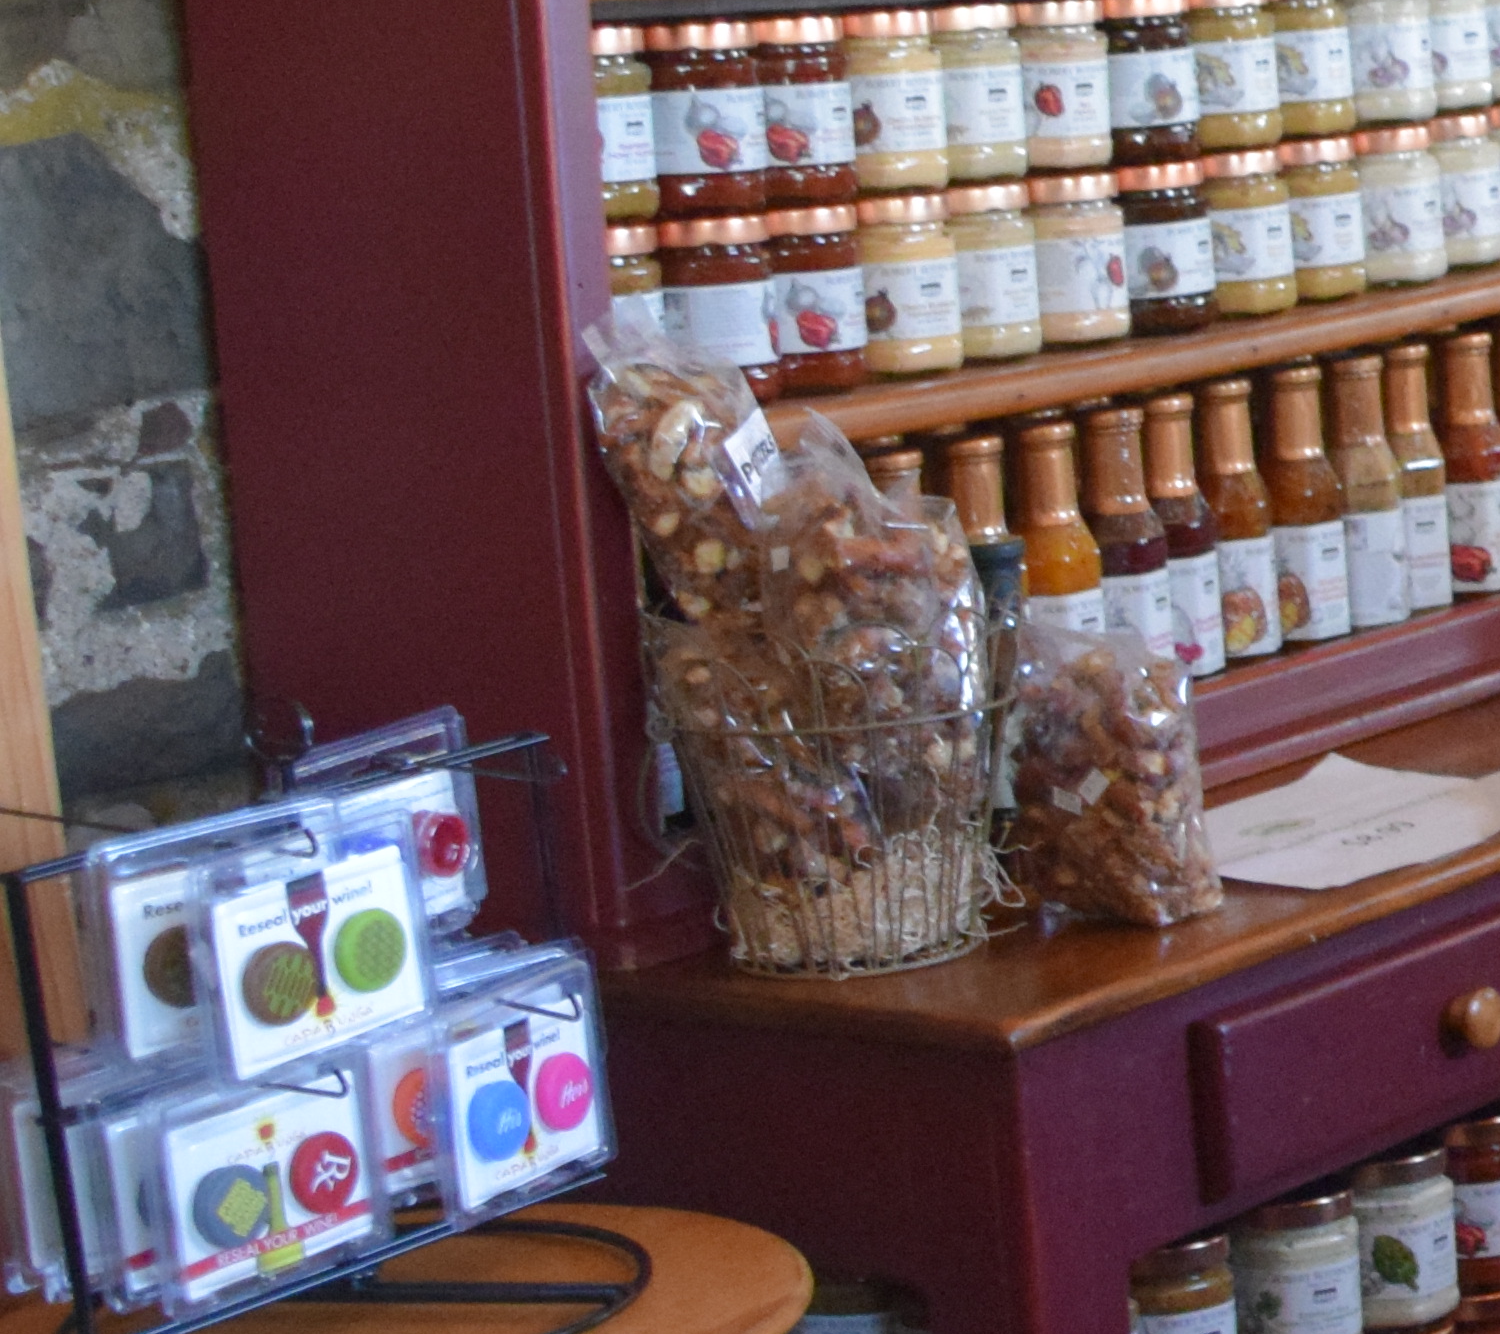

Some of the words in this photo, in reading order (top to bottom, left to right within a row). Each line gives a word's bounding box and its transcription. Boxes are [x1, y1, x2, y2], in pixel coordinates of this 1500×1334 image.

[142, 900, 184, 919] Rese
[236, 908, 289, 940] Reseal
[291, 899, 330, 925] your
[332, 880, 374, 907] wine!
[465, 1051, 505, 1079] Reseal
[507, 1045, 533, 1067] your
[533, 1028, 561, 1049] wine!
[217, 1243, 261, 1267] RESEAL
[263, 1228, 299, 1251] YOUR
